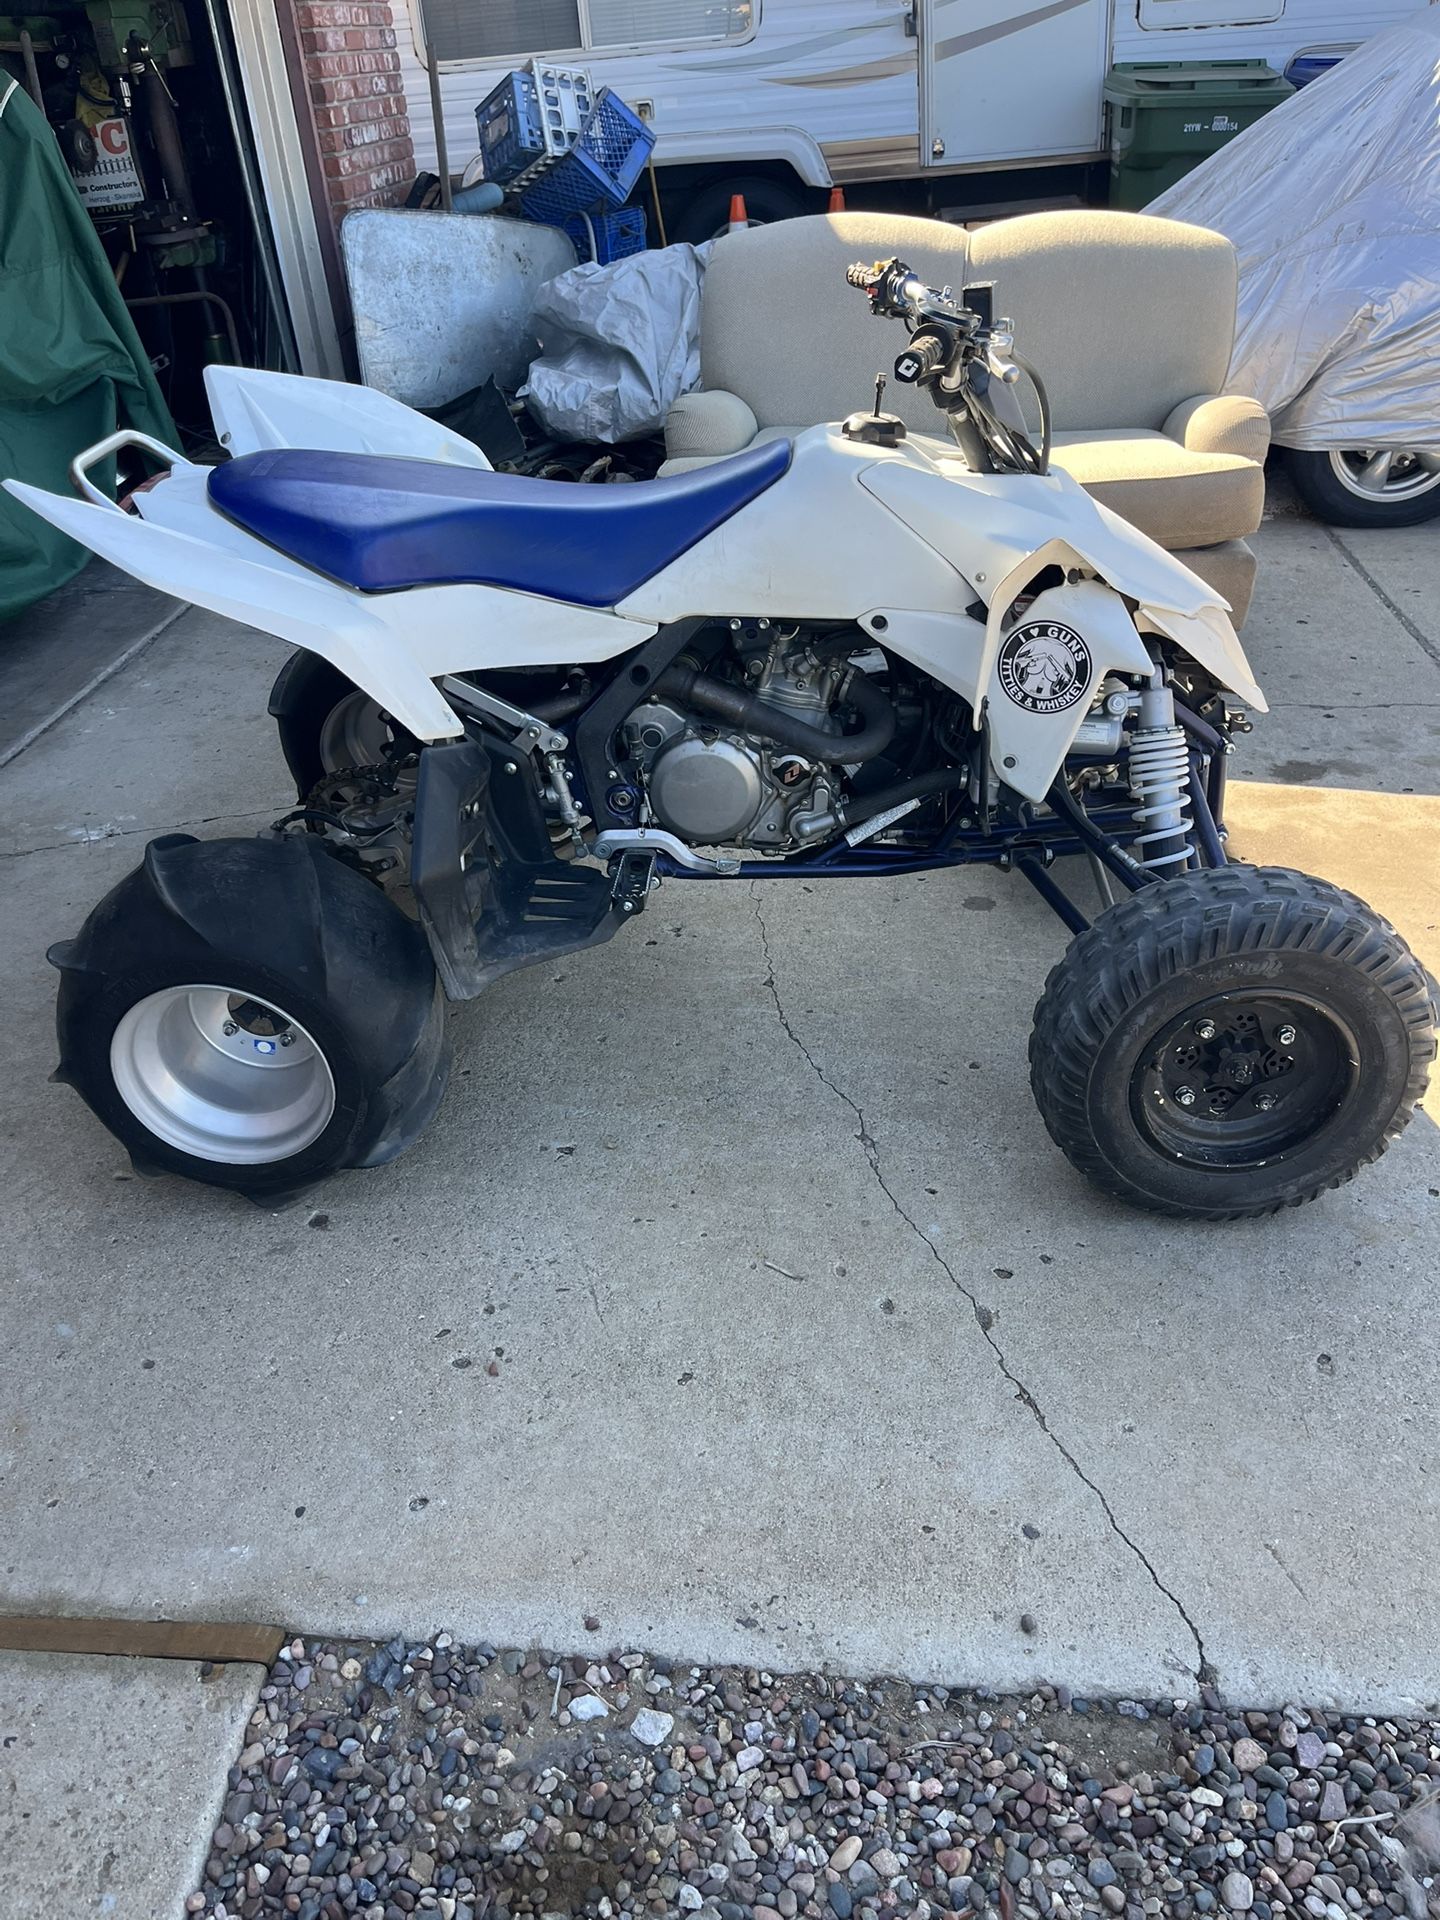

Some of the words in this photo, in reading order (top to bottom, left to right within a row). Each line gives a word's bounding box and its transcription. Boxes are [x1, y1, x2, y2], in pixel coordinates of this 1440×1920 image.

[89, 181, 137, 192] Constructors
[1018, 633, 1026, 643] I
[1047, 627, 1086, 662] GUNS
[1002, 657, 1024, 700] TITTIES
[1024, 697, 1033, 707] &
[1036, 680, 1083, 710] WHISKEY
